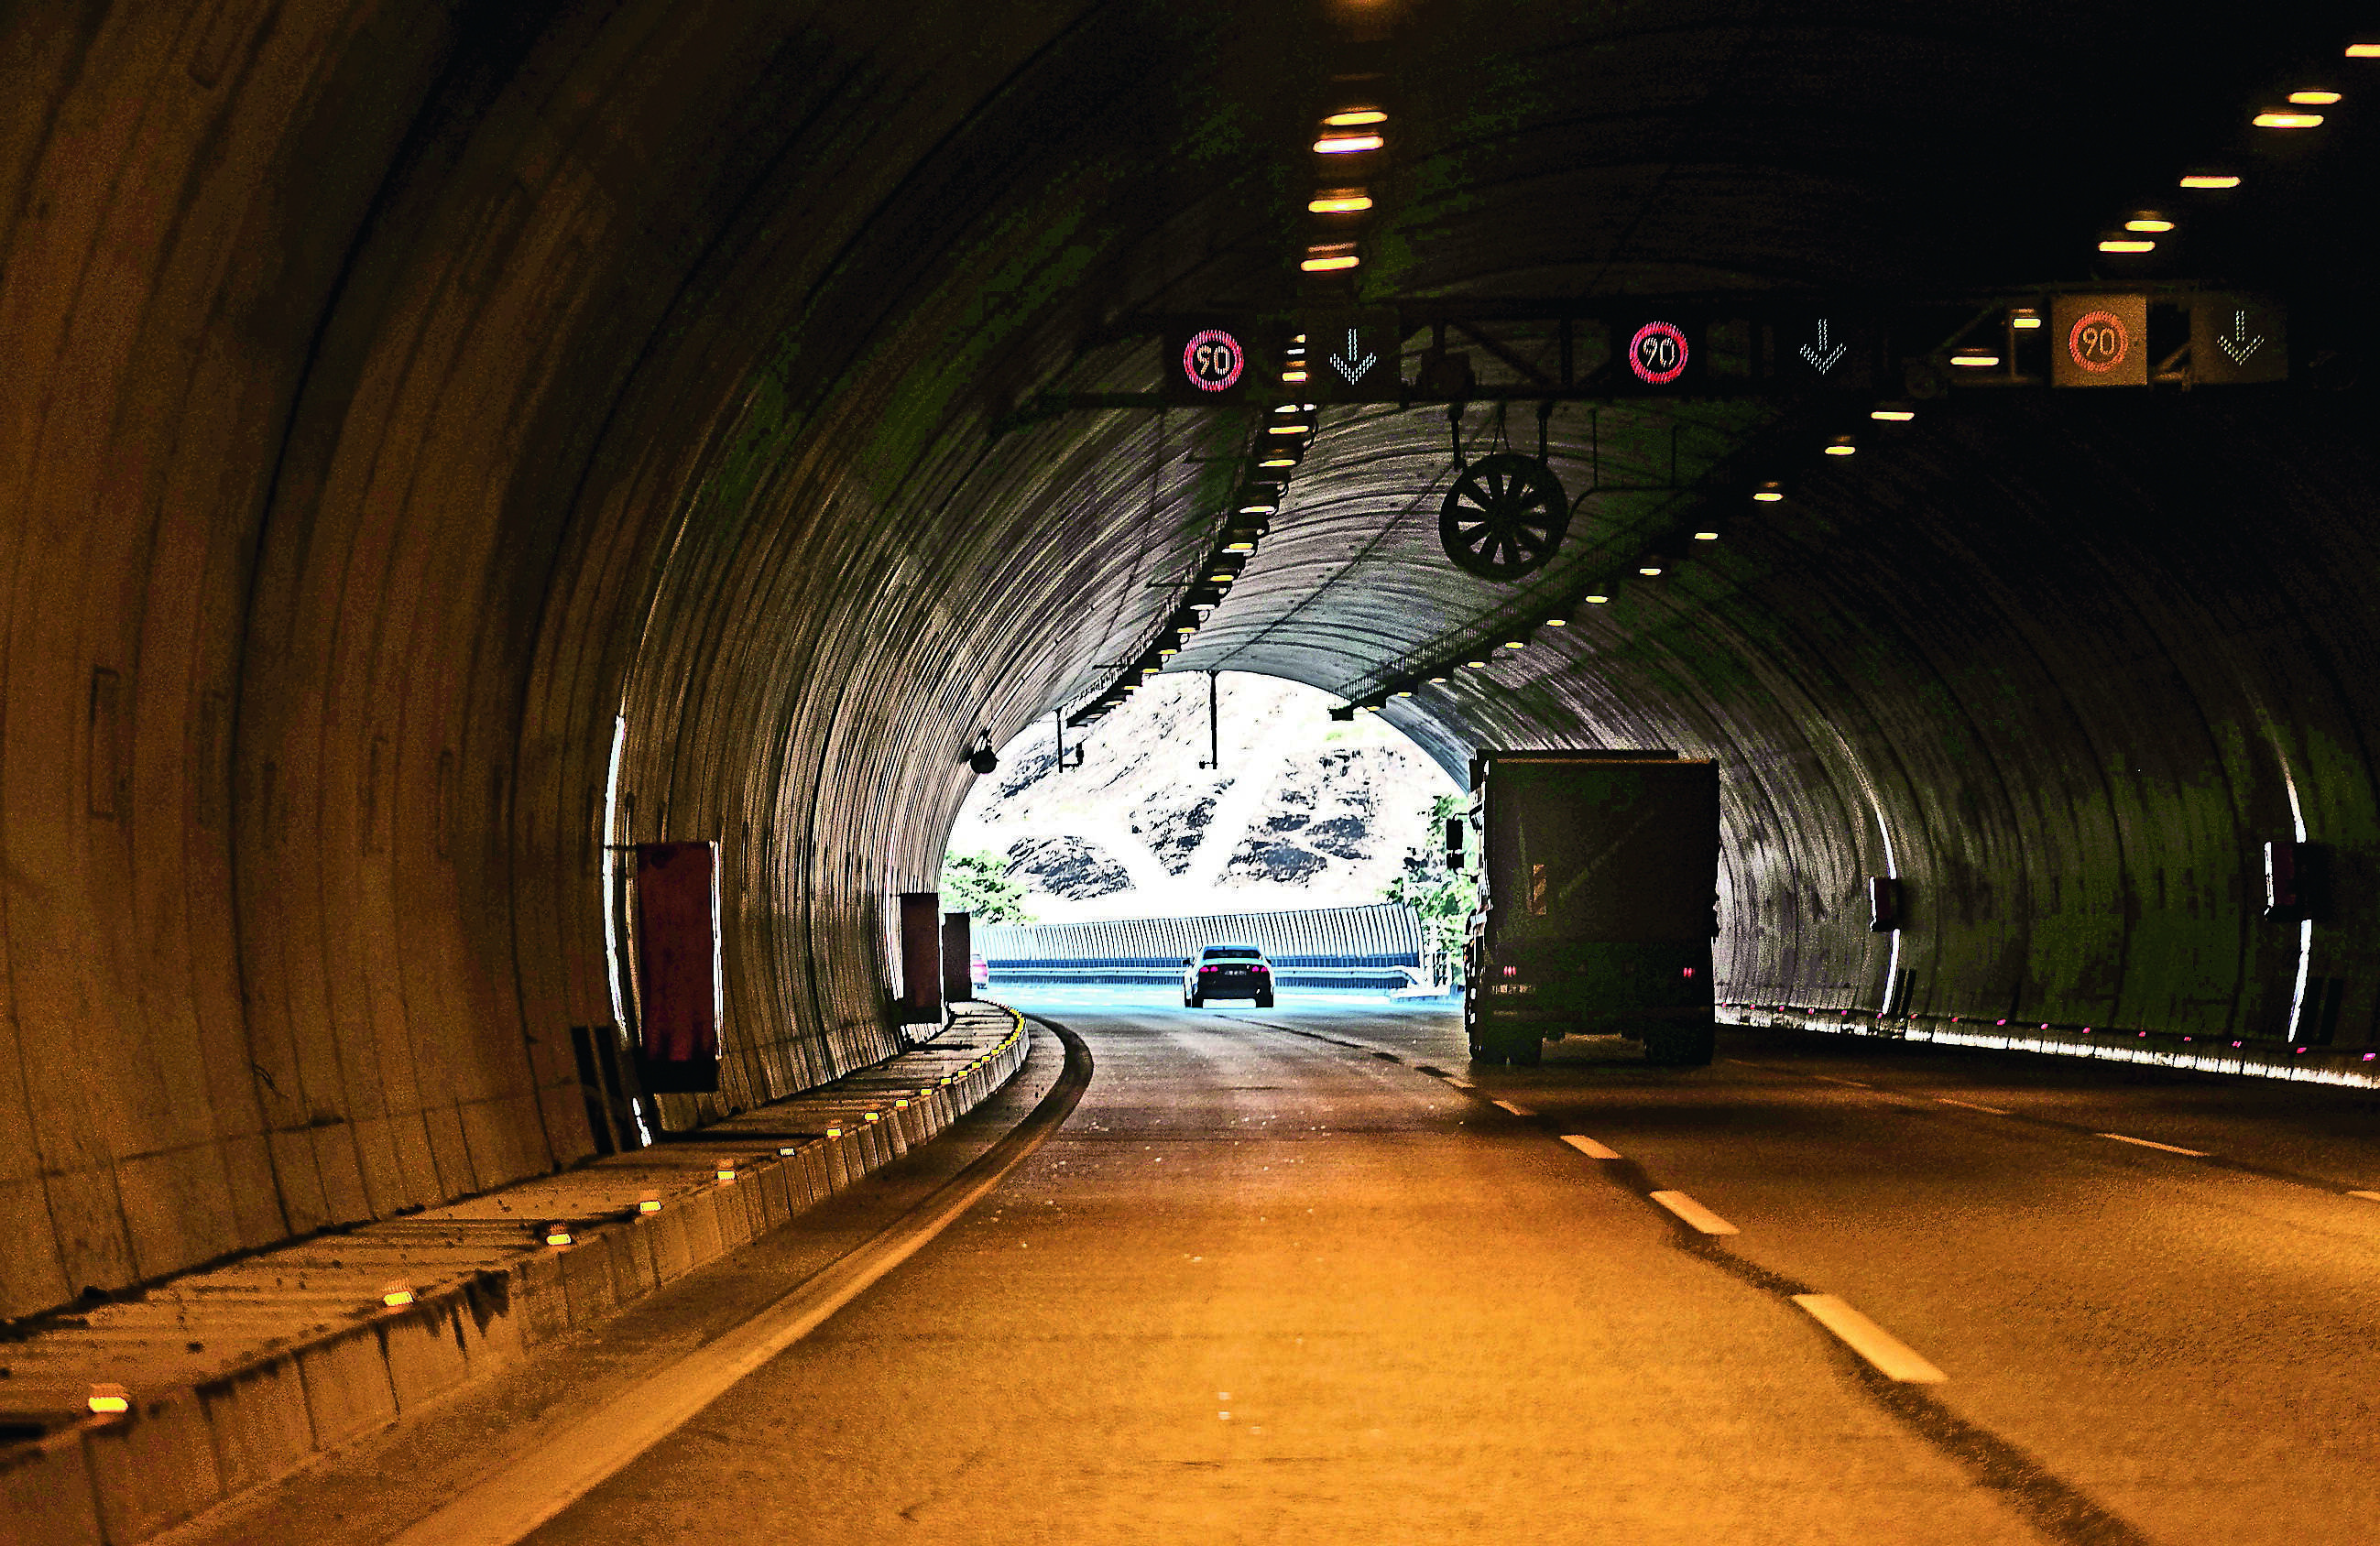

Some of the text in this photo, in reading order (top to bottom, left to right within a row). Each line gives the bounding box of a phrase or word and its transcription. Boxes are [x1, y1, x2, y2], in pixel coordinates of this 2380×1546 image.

[1643, 337, 1675, 367] 90
[2083, 327, 2115, 356] 90
[1196, 345, 1230, 376] 90
